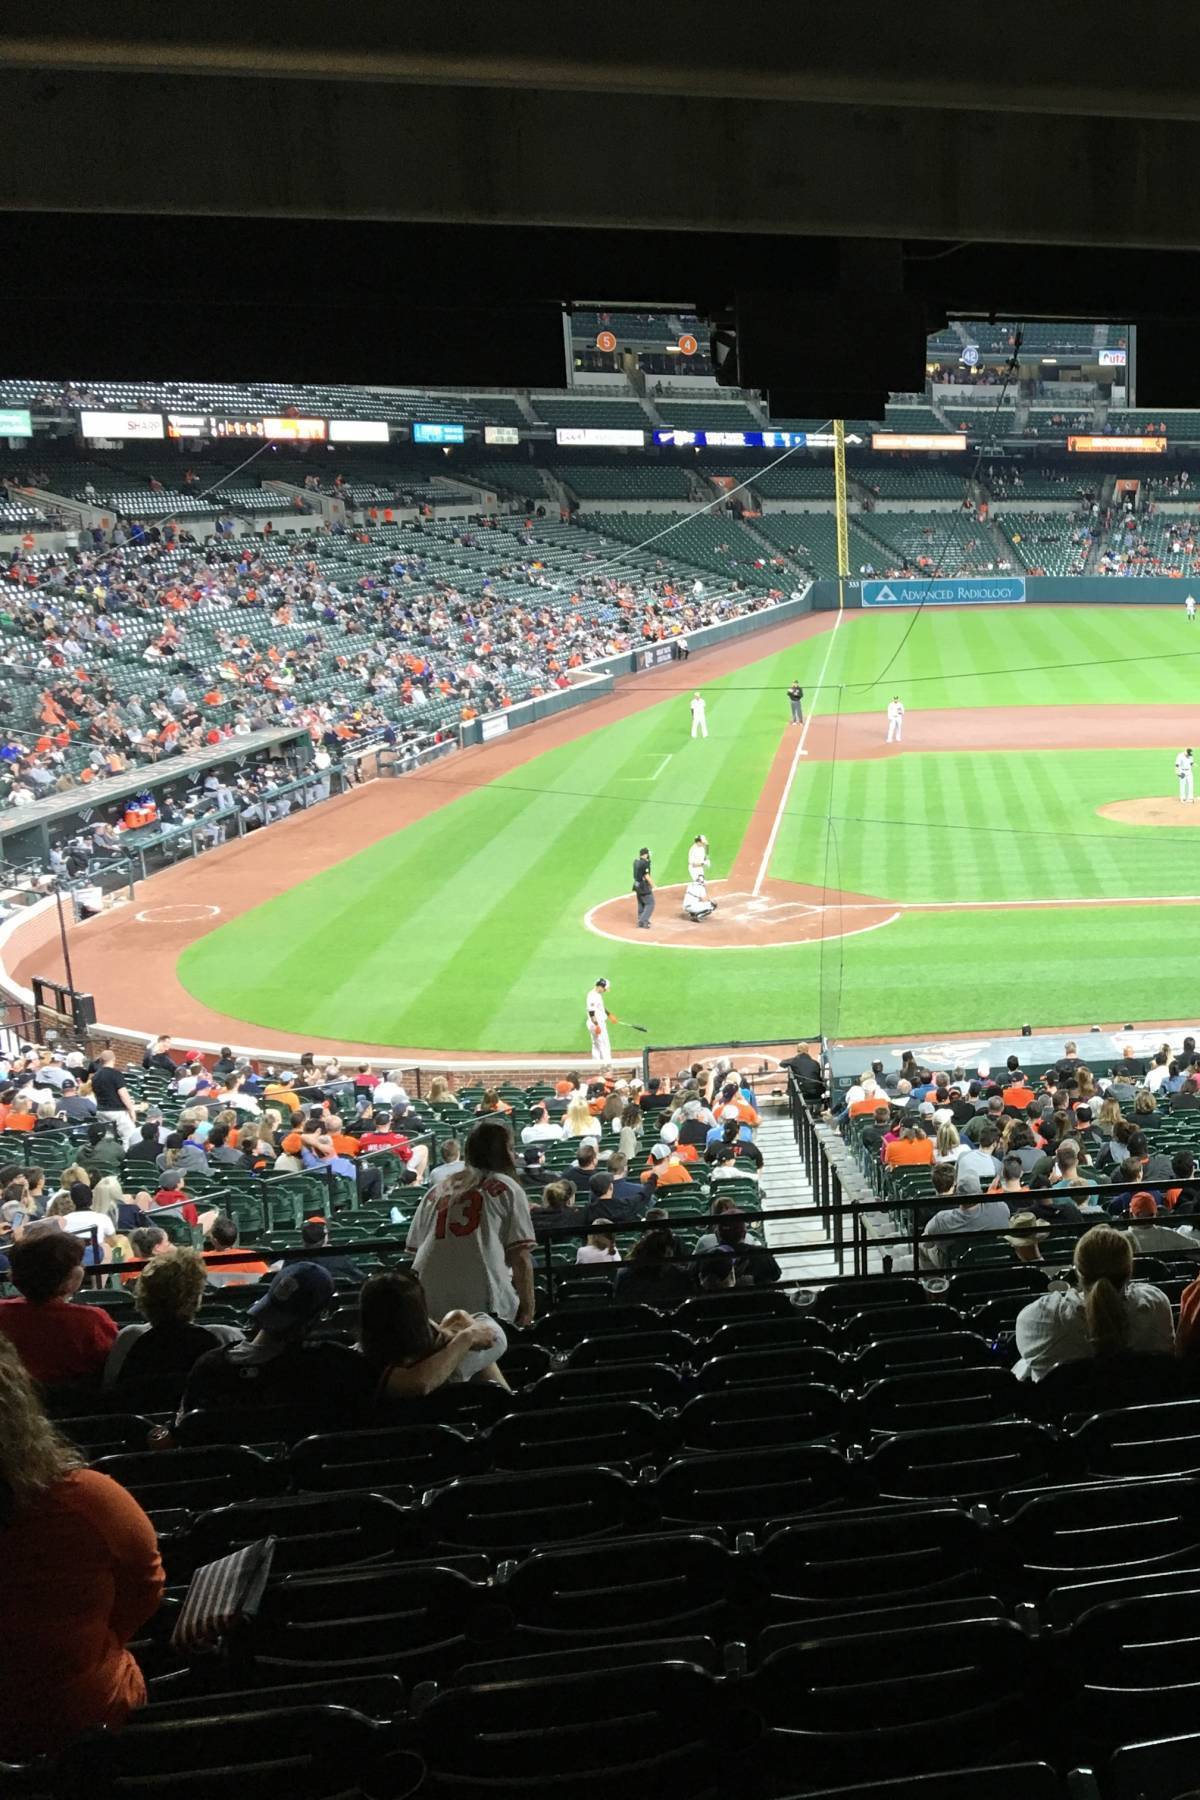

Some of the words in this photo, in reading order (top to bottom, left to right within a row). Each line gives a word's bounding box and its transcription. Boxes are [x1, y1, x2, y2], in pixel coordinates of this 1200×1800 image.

[963, 351, 977, 362] 42
[127, 420, 160, 431] SHARP
[901, 588, 954, 600] ADVANCED
[957, 586, 1014, 600] RADIOLOGY
[435, 1188, 483, 1239] 13
